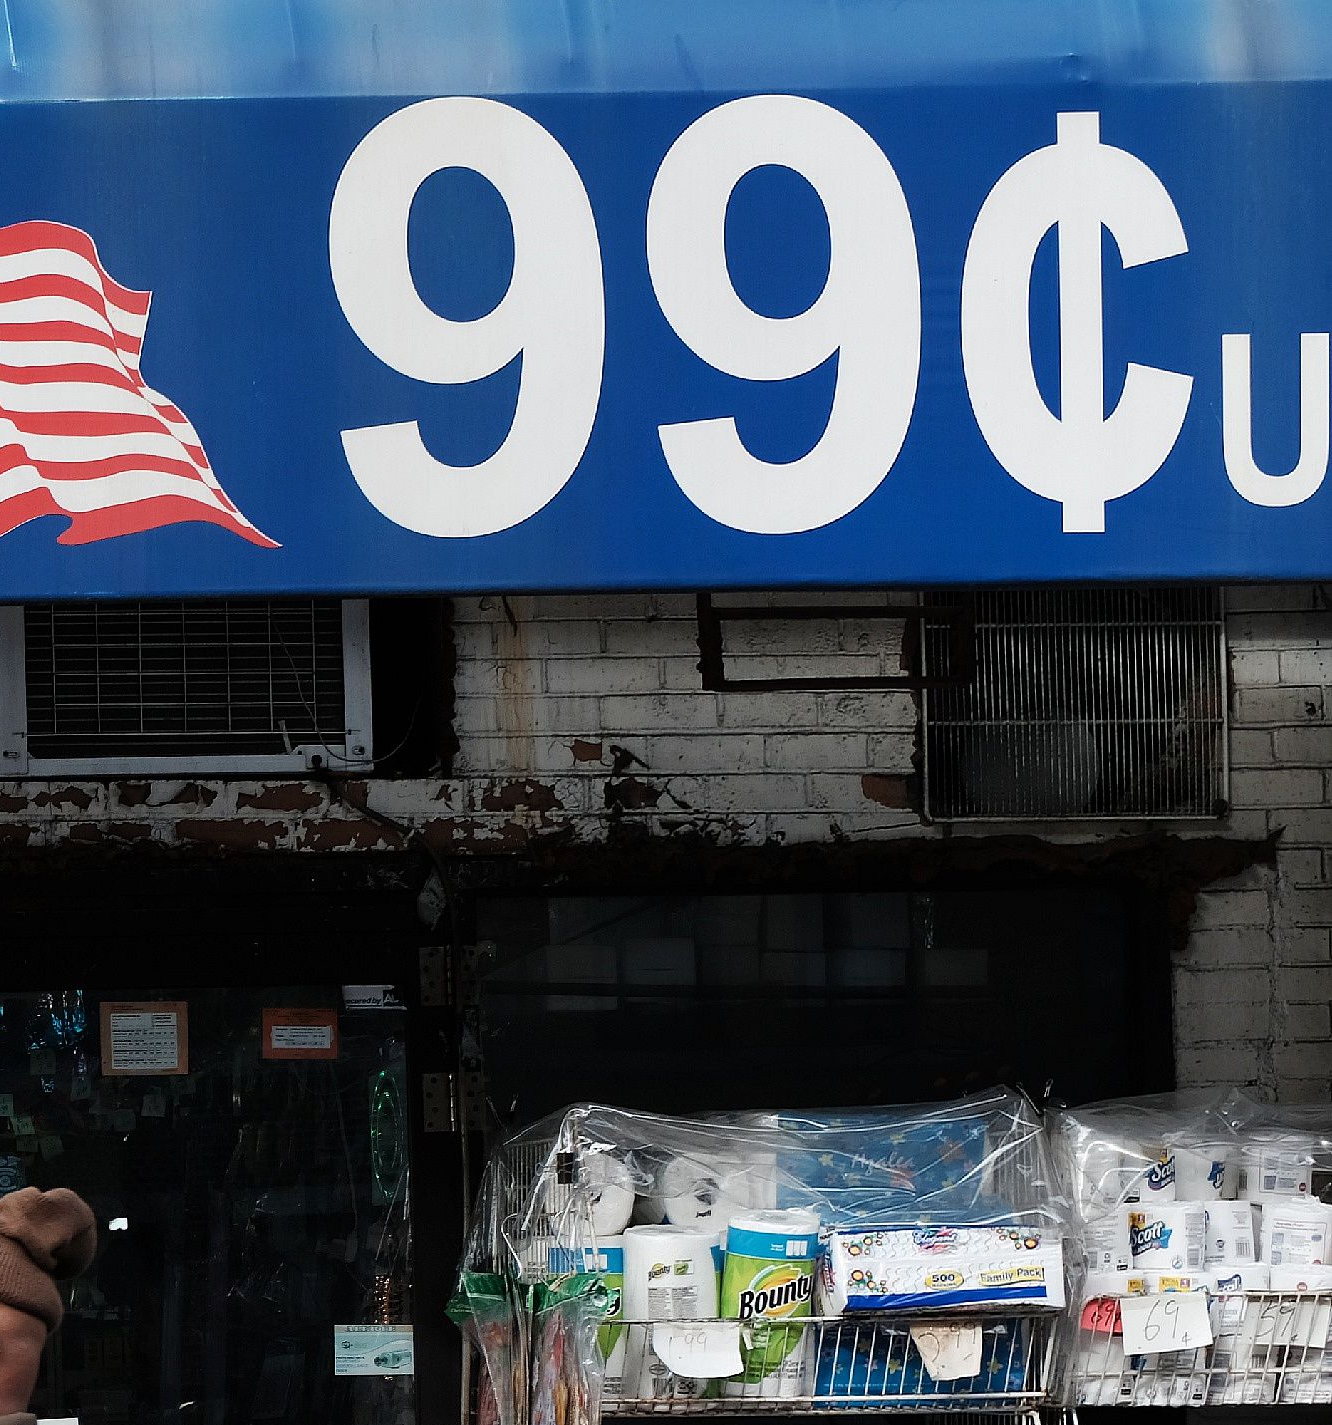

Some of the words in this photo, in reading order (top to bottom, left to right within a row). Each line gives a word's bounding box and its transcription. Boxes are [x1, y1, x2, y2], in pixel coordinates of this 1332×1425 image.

[328, 94, 1193, 538] 99¢
[739, 1272, 813, 1321] Bounty
[931, 1273, 956, 1284] 500
[980, 1271, 1014, 1283] Family
[1016, 1268, 1042, 1279] Pack
